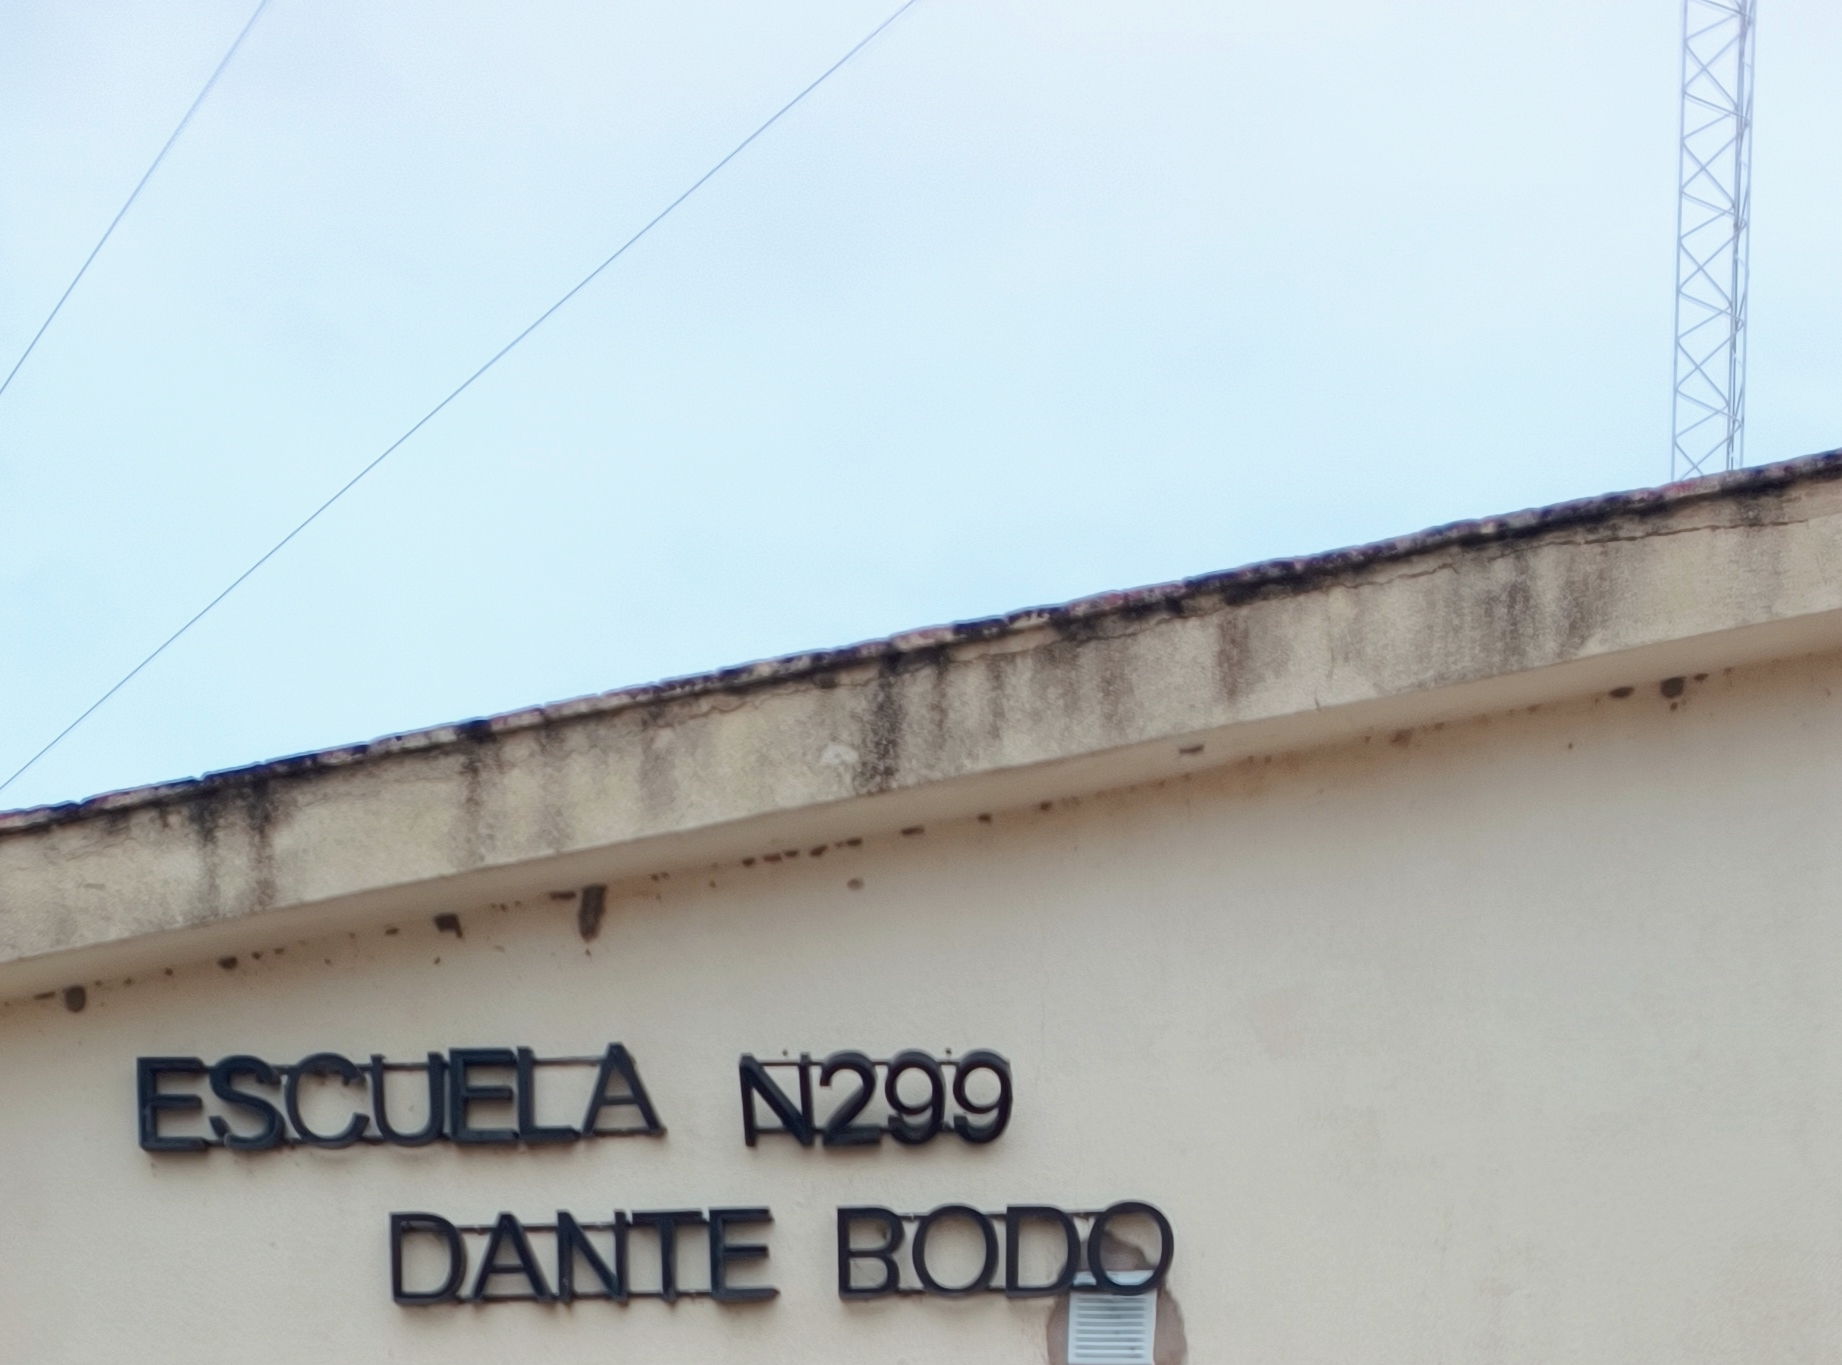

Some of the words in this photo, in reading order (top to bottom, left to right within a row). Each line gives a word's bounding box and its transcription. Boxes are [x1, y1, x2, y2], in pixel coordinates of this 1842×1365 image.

[136, 1042, 667, 1152] ESCUELA
[739, 1048, 1014, 1148] N299
[388, 1208, 781, 1306] DANTE
[837, 1201, 1175, 1300] BODO
